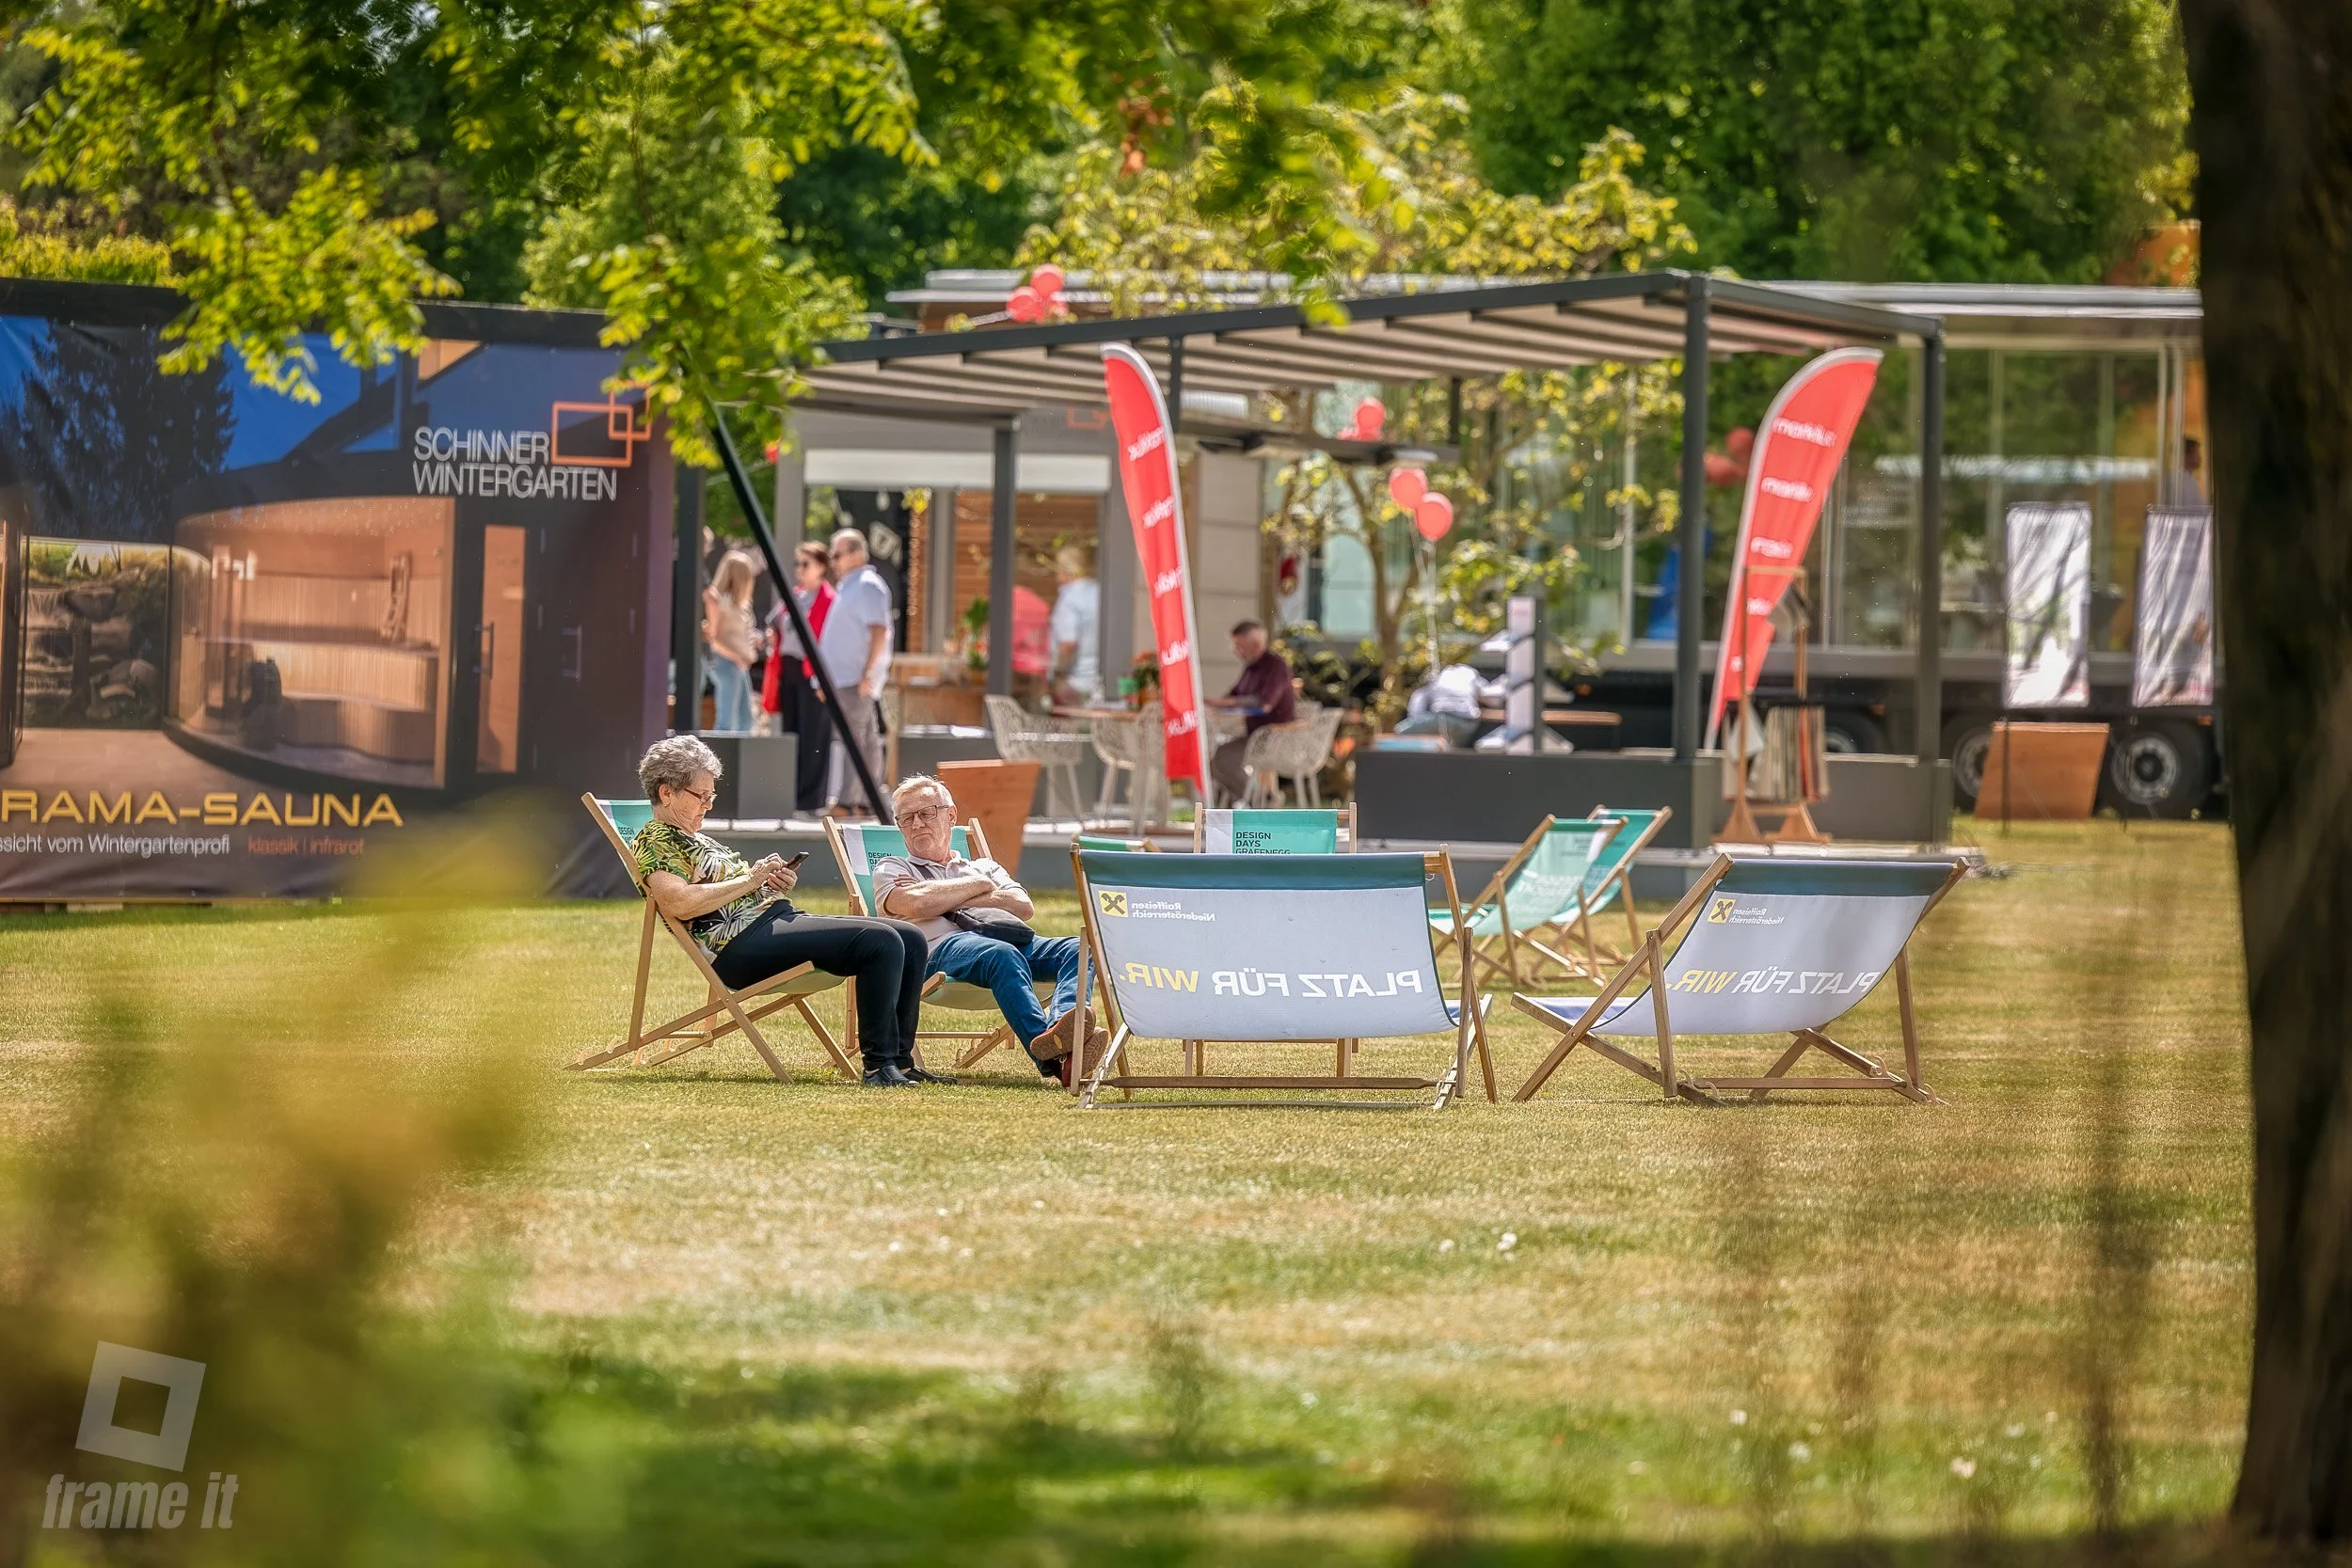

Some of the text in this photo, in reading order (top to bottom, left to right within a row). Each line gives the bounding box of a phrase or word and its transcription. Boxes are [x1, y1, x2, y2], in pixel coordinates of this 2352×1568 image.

[414, 426, 550, 465] SCHINNER
[412, 461, 617, 501] WINTERGARTEN
[47, 835, 84, 853] vom
[87, 833, 230, 859] Wintergartenprofi
[1235, 832, 1272, 840] DESIGN
